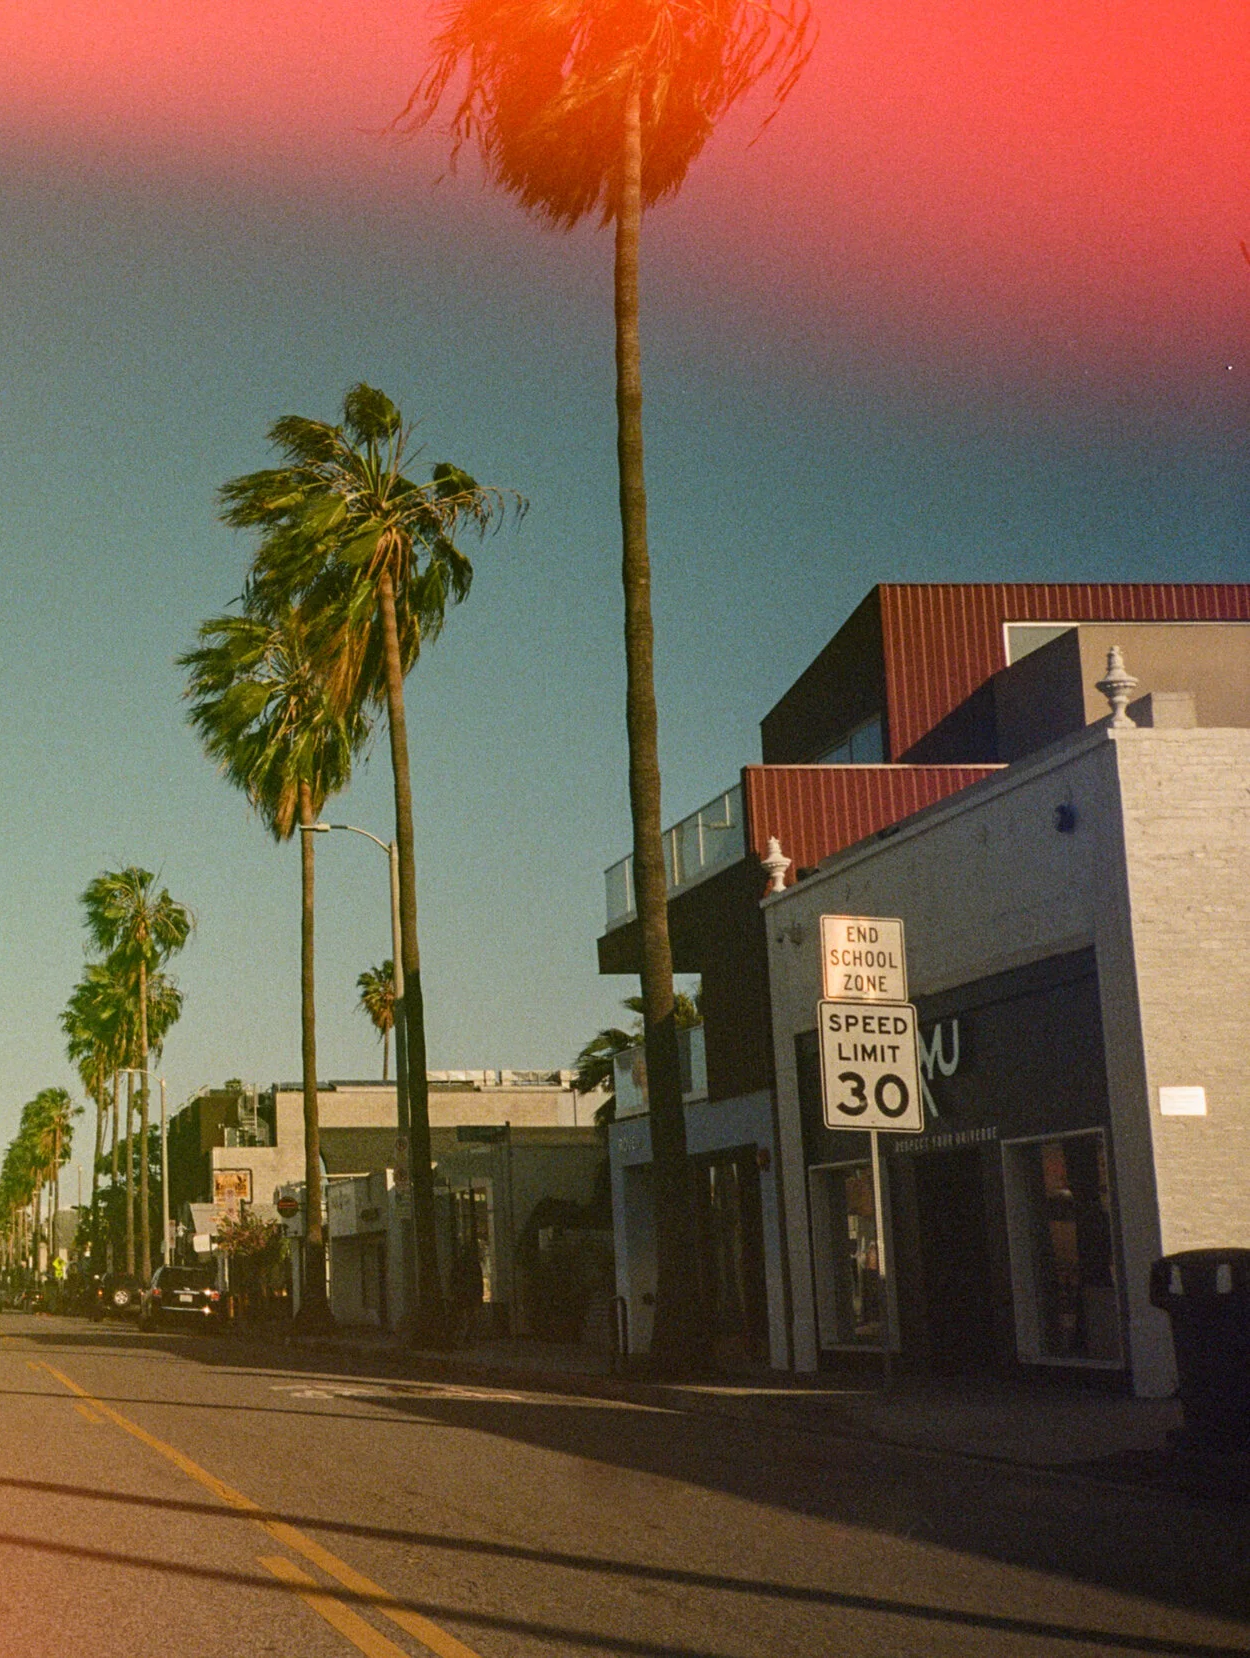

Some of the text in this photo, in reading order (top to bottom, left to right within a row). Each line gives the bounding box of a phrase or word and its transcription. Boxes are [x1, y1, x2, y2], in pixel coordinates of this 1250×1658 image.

[846, 927, 879, 944] END
[830, 949, 898, 969] SCHOOL
[843, 974, 888, 993] ZONE
[828, 1014, 908, 1035] SPEED
[837, 1042, 900, 1063] LIMIT
[836, 1071, 909, 1119] 30
